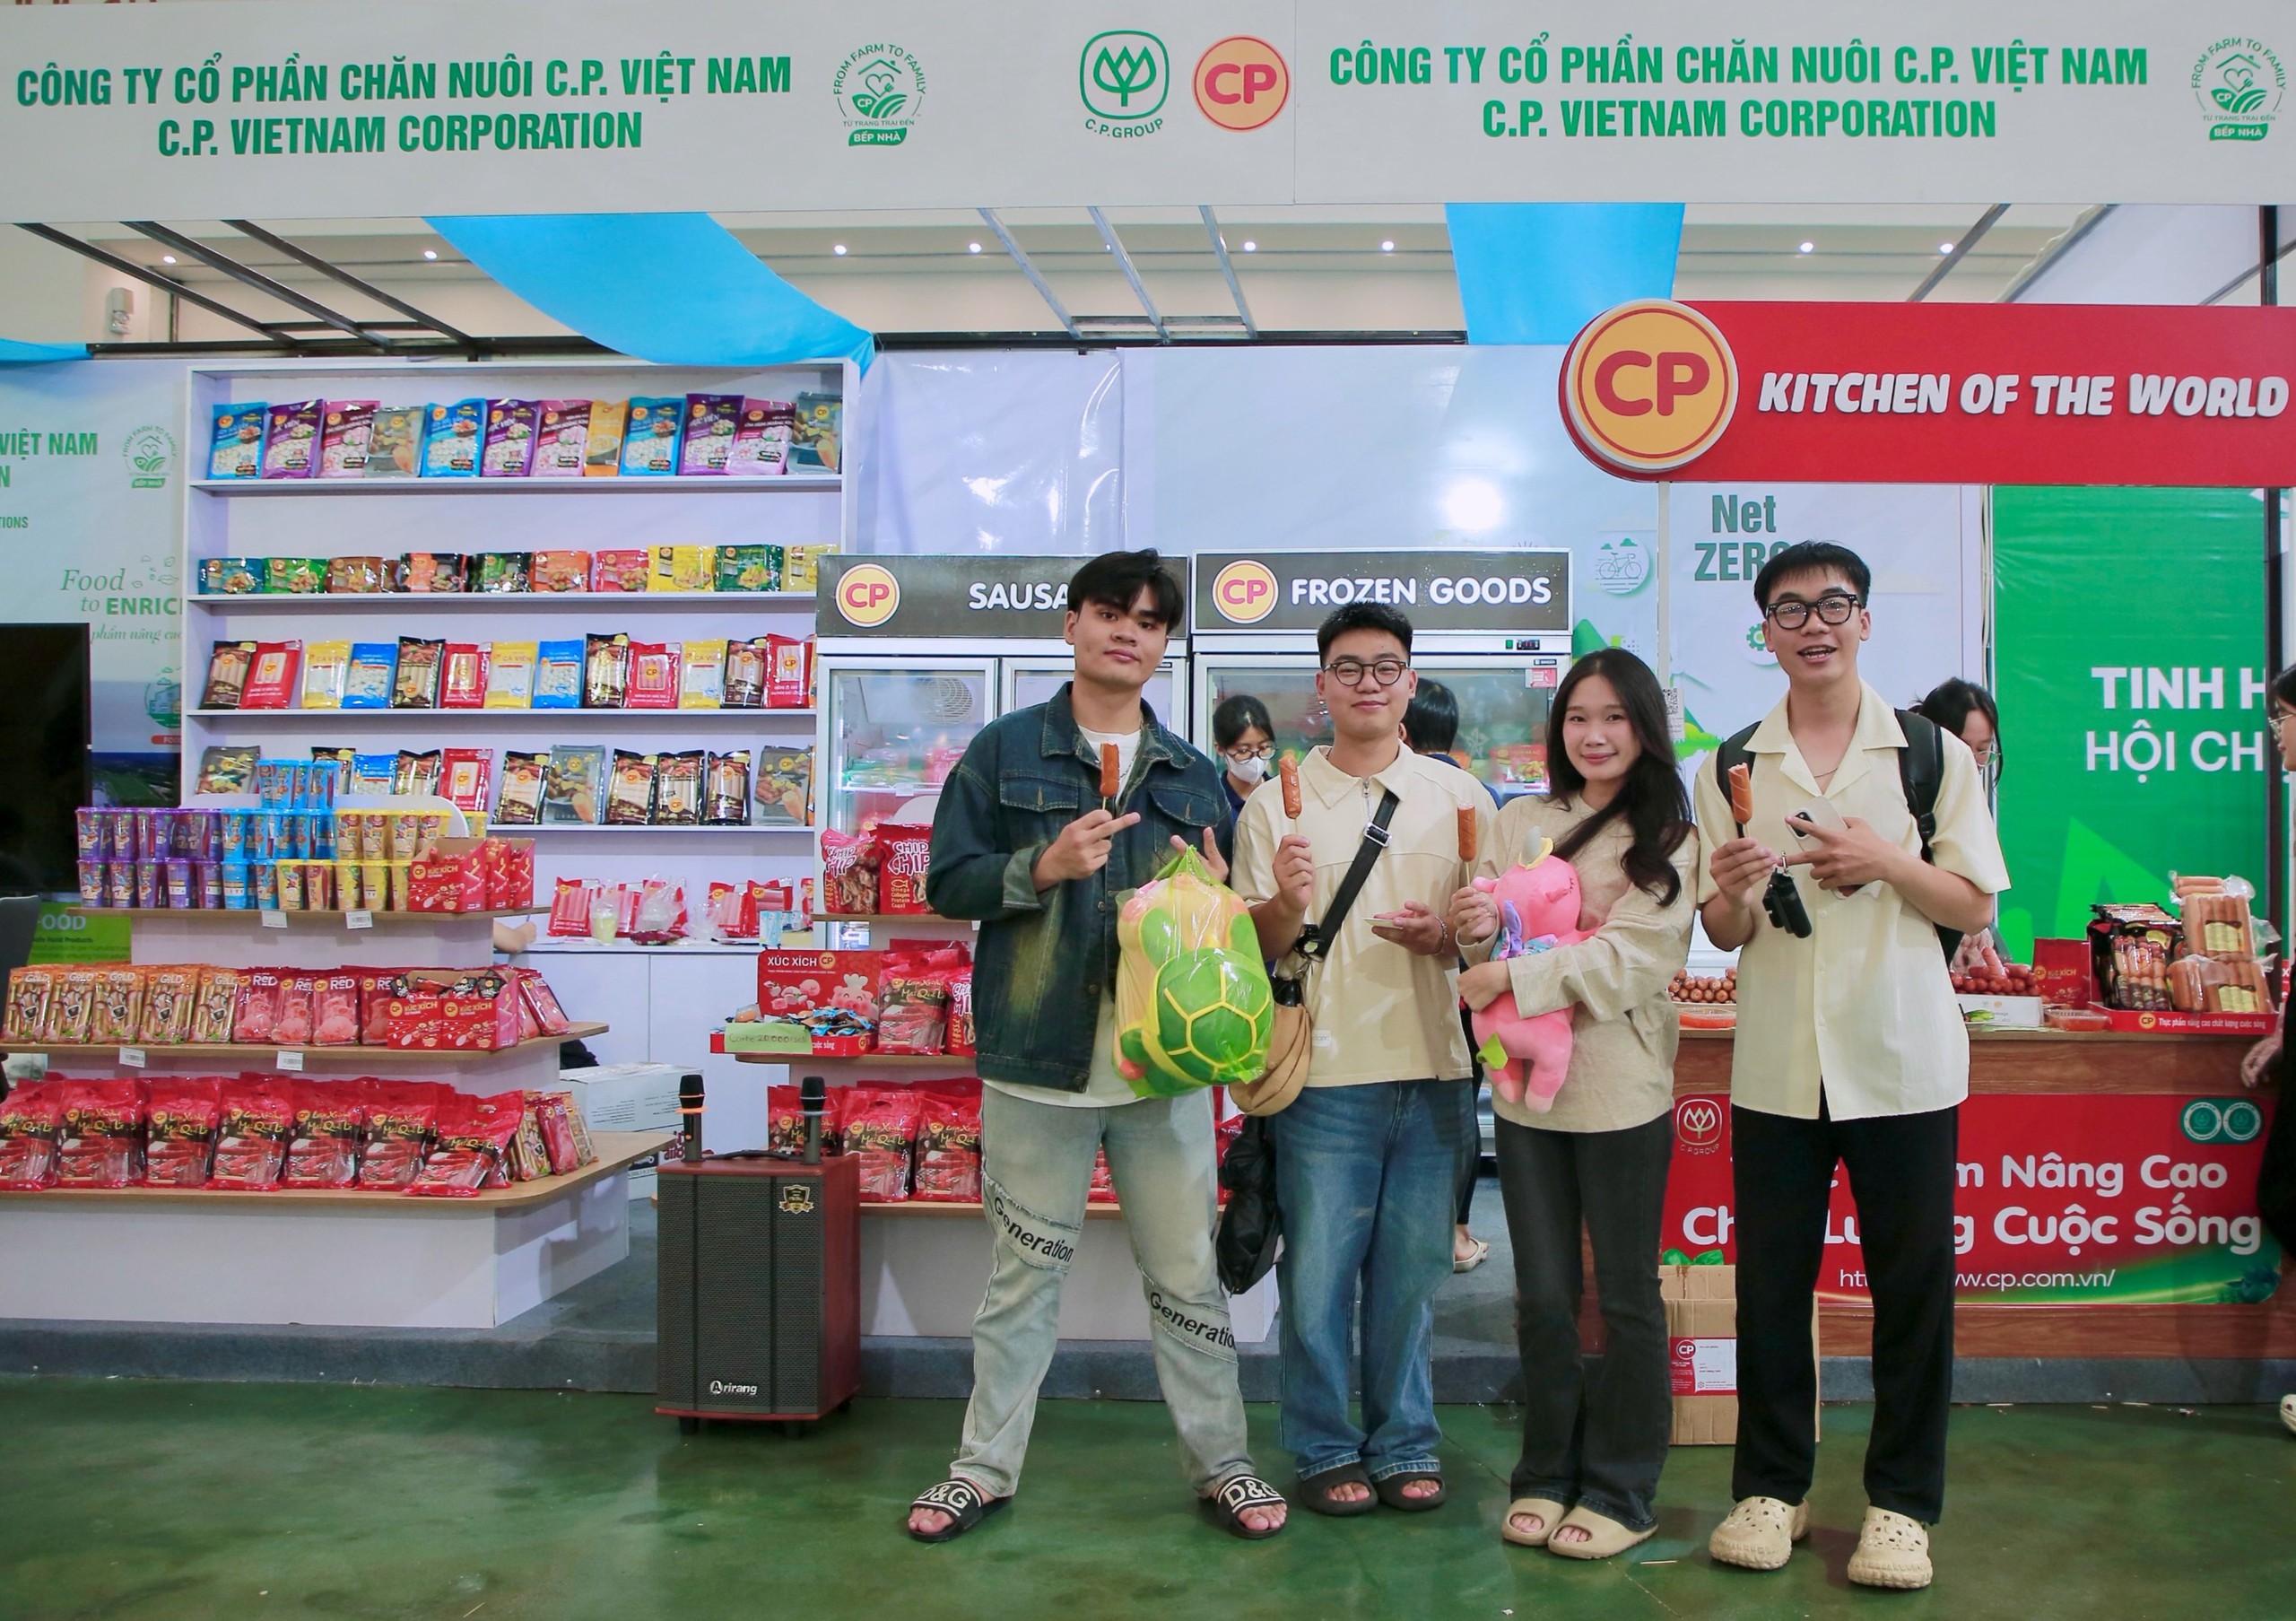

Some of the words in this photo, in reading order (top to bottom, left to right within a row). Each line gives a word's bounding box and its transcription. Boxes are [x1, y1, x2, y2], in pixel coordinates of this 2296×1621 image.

[833, 60, 852, 95] FROM
[850, 43, 883, 62] FARM
[888, 44, 904, 57] TO
[904, 54, 926, 95] FAMILY
[1330, 39, 1431, 85] CÔNG
[1443, 46, 1486, 84] TY
[1499, 31, 1550, 83] CỔ
[1561, 32, 1664, 83] PHẦN
[1676, 38, 1779, 83] CHĂN
[1792, 38, 1882, 83] NUÔI
[1895, 45, 1960, 83] C.P.
[1971, 38, 2050, 92] VIỆT
[2062, 47, 2148, 85] NAM
[2192, 54, 2210, 88] FROM
[2208, 38, 2241, 55] FARM
[2246, 39, 2262, 52] TO
[2263, 48, 2286, 90] FAMILY
[16, 61, 110, 105] CÔNG
[122, 67, 161, 103] TY
[174, 51, 222, 103] CỔ
[231, 52, 326, 101] PHẦN
[339, 55, 436, 100] CHĂN
[448, 52, 532, 97] NUÔI
[545, 58, 608, 96] C.P.
[620, 49, 696, 102] VIỆT
[707, 56, 791, 93] NAM
[1205, 63, 1277, 105] CP
[857, 99, 873, 108] CP
[1483, 99, 1548, 137] C.P.
[1560, 99, 1721, 137] VIETNAM
[1740, 99, 1996, 138] CORPORATION
[158, 118, 218, 156] C.P.
[230, 115, 385, 155] VIETNAM
[398, 110, 642, 151] CORPORATION
[854, 130, 874, 143] BẾP
[877, 130, 901, 142] NHÀ
[2214, 126, 2235, 136] BẾP
[2238, 126, 2264, 136] NHÀ
[1594, 350, 1710, 417] CP
[1758, 372, 1951, 414] KITCHEN
[1961, 373, 2019, 414] OF
[2031, 376, 2115, 415] THE
[2128, 376, 2289, 417] WORLD
[49, 432, 98, 456] NAM
[1712, 494, 1777, 534] Net
[60, 568, 126, 592] Food
[1223, 580, 1267, 604] CP
[1292, 578, 1416, 606] FROZEN
[1429, 576, 1551, 606] GOODS
[81, 597, 100, 612] to
[846, 583, 890, 608] CP
[2092, 667, 2223, 709] TINH
[2087, 720, 2174, 782] HỘI
[2191, 731, 2264, 771] CH
[892, 841, 930, 855] CHIP
[888, 852, 930, 876] CHIP
[38, 914, 86, 930] OOD
[768, 954, 790, 966] XÚC
[792, 954, 817, 967] XÍCH
[822, 956, 833, 965] CP
[2141, 1016, 2154, 1024] CP
[2003, 1152, 2123, 1198] Nâng
[2141, 1155, 2227, 1189] Cao
[994, 1195, 1074, 1264] Generation
[1683, 1205, 1735, 1245] Ch
[1994, 1203, 2118, 1256] Cuộc
[2135, 1191, 2261, 1256] Sống
[1150, 1291, 1236, 1350] Generatio
[1679, 1345, 1694, 1355] CP
[710, 1381, 758, 1395] Arirang
[1224, 1480, 1280, 1508] D&G
